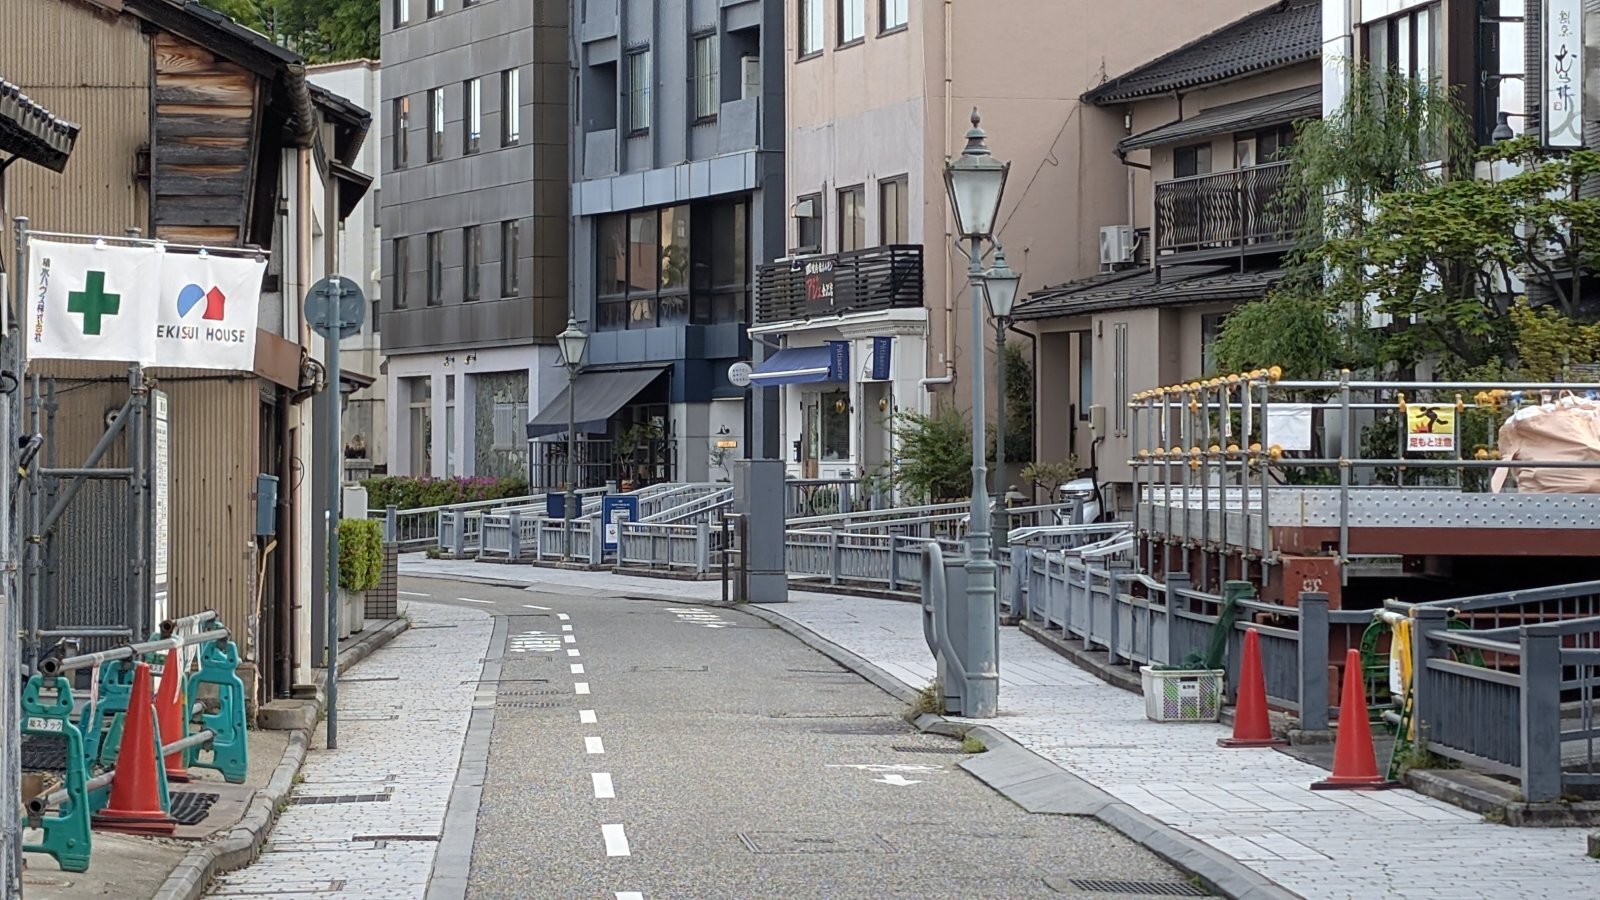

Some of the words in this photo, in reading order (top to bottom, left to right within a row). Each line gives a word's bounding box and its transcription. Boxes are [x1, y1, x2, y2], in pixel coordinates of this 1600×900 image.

[156, 324, 199, 340] EKISUI
[205, 327, 246, 343] HOUSE
[1410, 438, 1452, 447] 足もと注意
